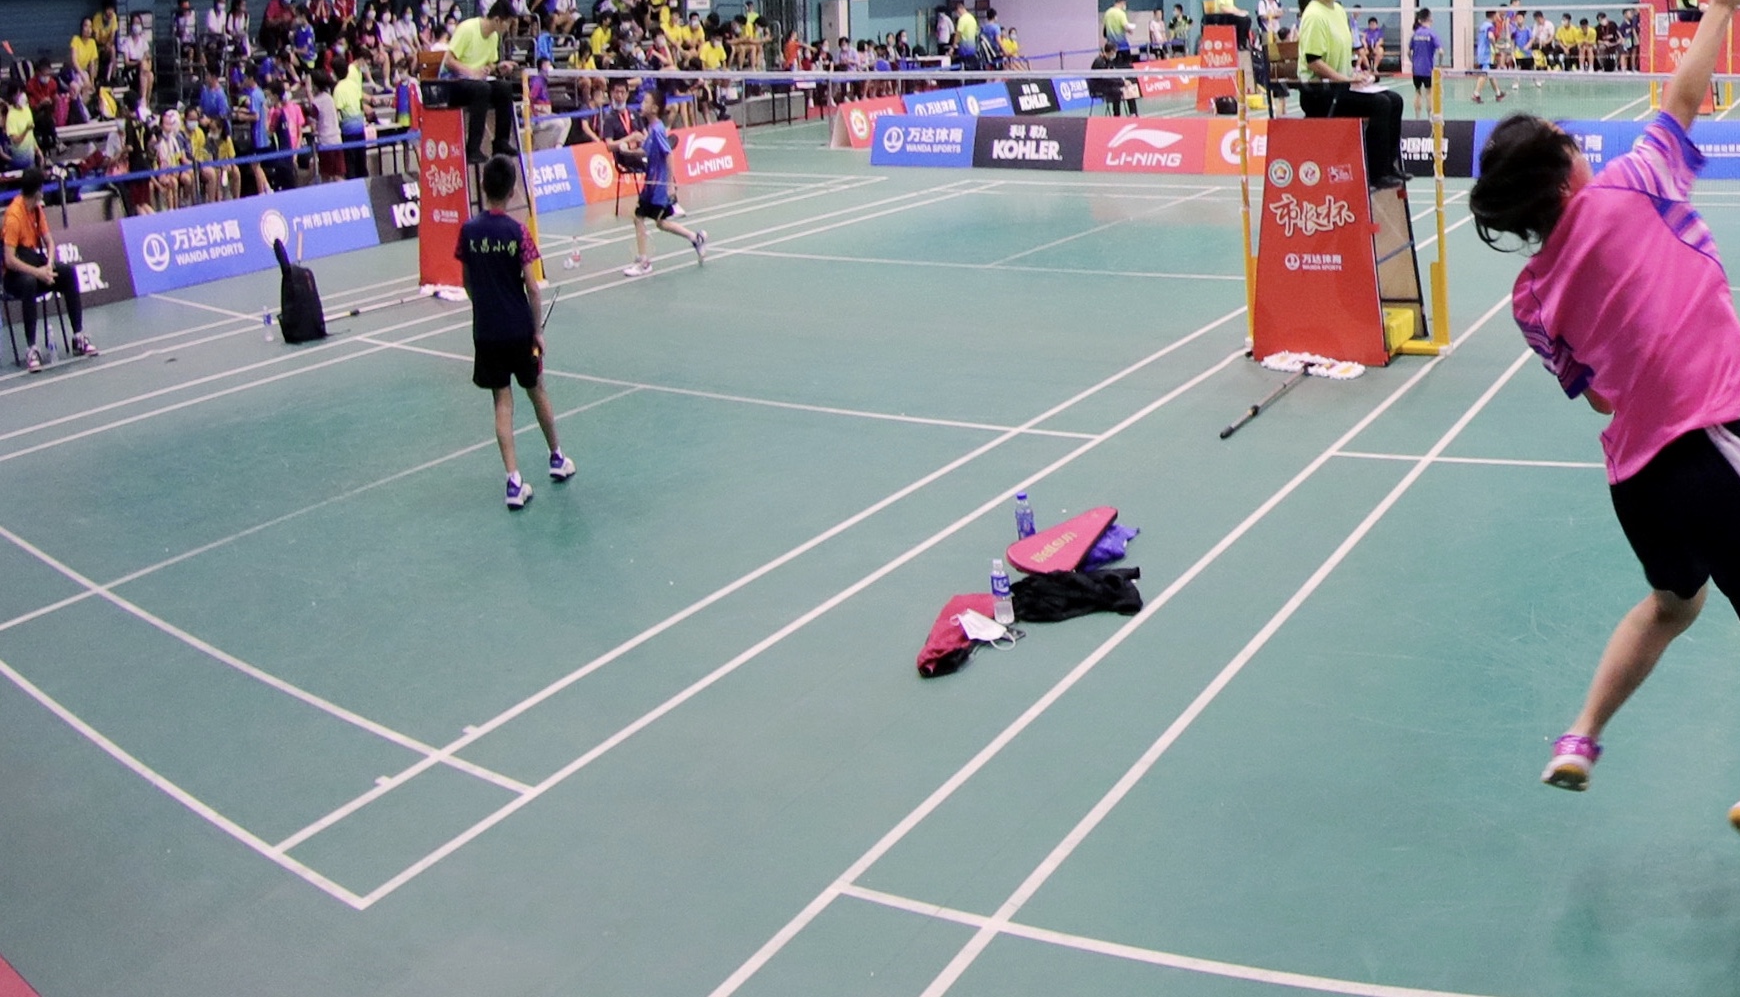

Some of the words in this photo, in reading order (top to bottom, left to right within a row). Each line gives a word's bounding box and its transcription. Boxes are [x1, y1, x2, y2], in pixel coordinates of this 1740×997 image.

[1018, 94, 1051, 111] KOHLER
[906, 127, 963, 143] 万达体育
[1009, 124, 1048, 139] 科勒
[906, 143, 932, 153] WANDA
[932, 144, 961, 154] SPORTS
[992, 140, 1060, 161] KOHLER
[687, 155, 733, 178] LI-NING
[1105, 152, 1183, 167] LI-NING
[293, 206, 371, 232] 广州市羽毛球协会
[172, 219, 241, 251] 万达体育
[175, 247, 208, 266] WANDA
[209, 243, 245, 260] SPORTS
[1302, 254, 1342, 265] 万达体育
